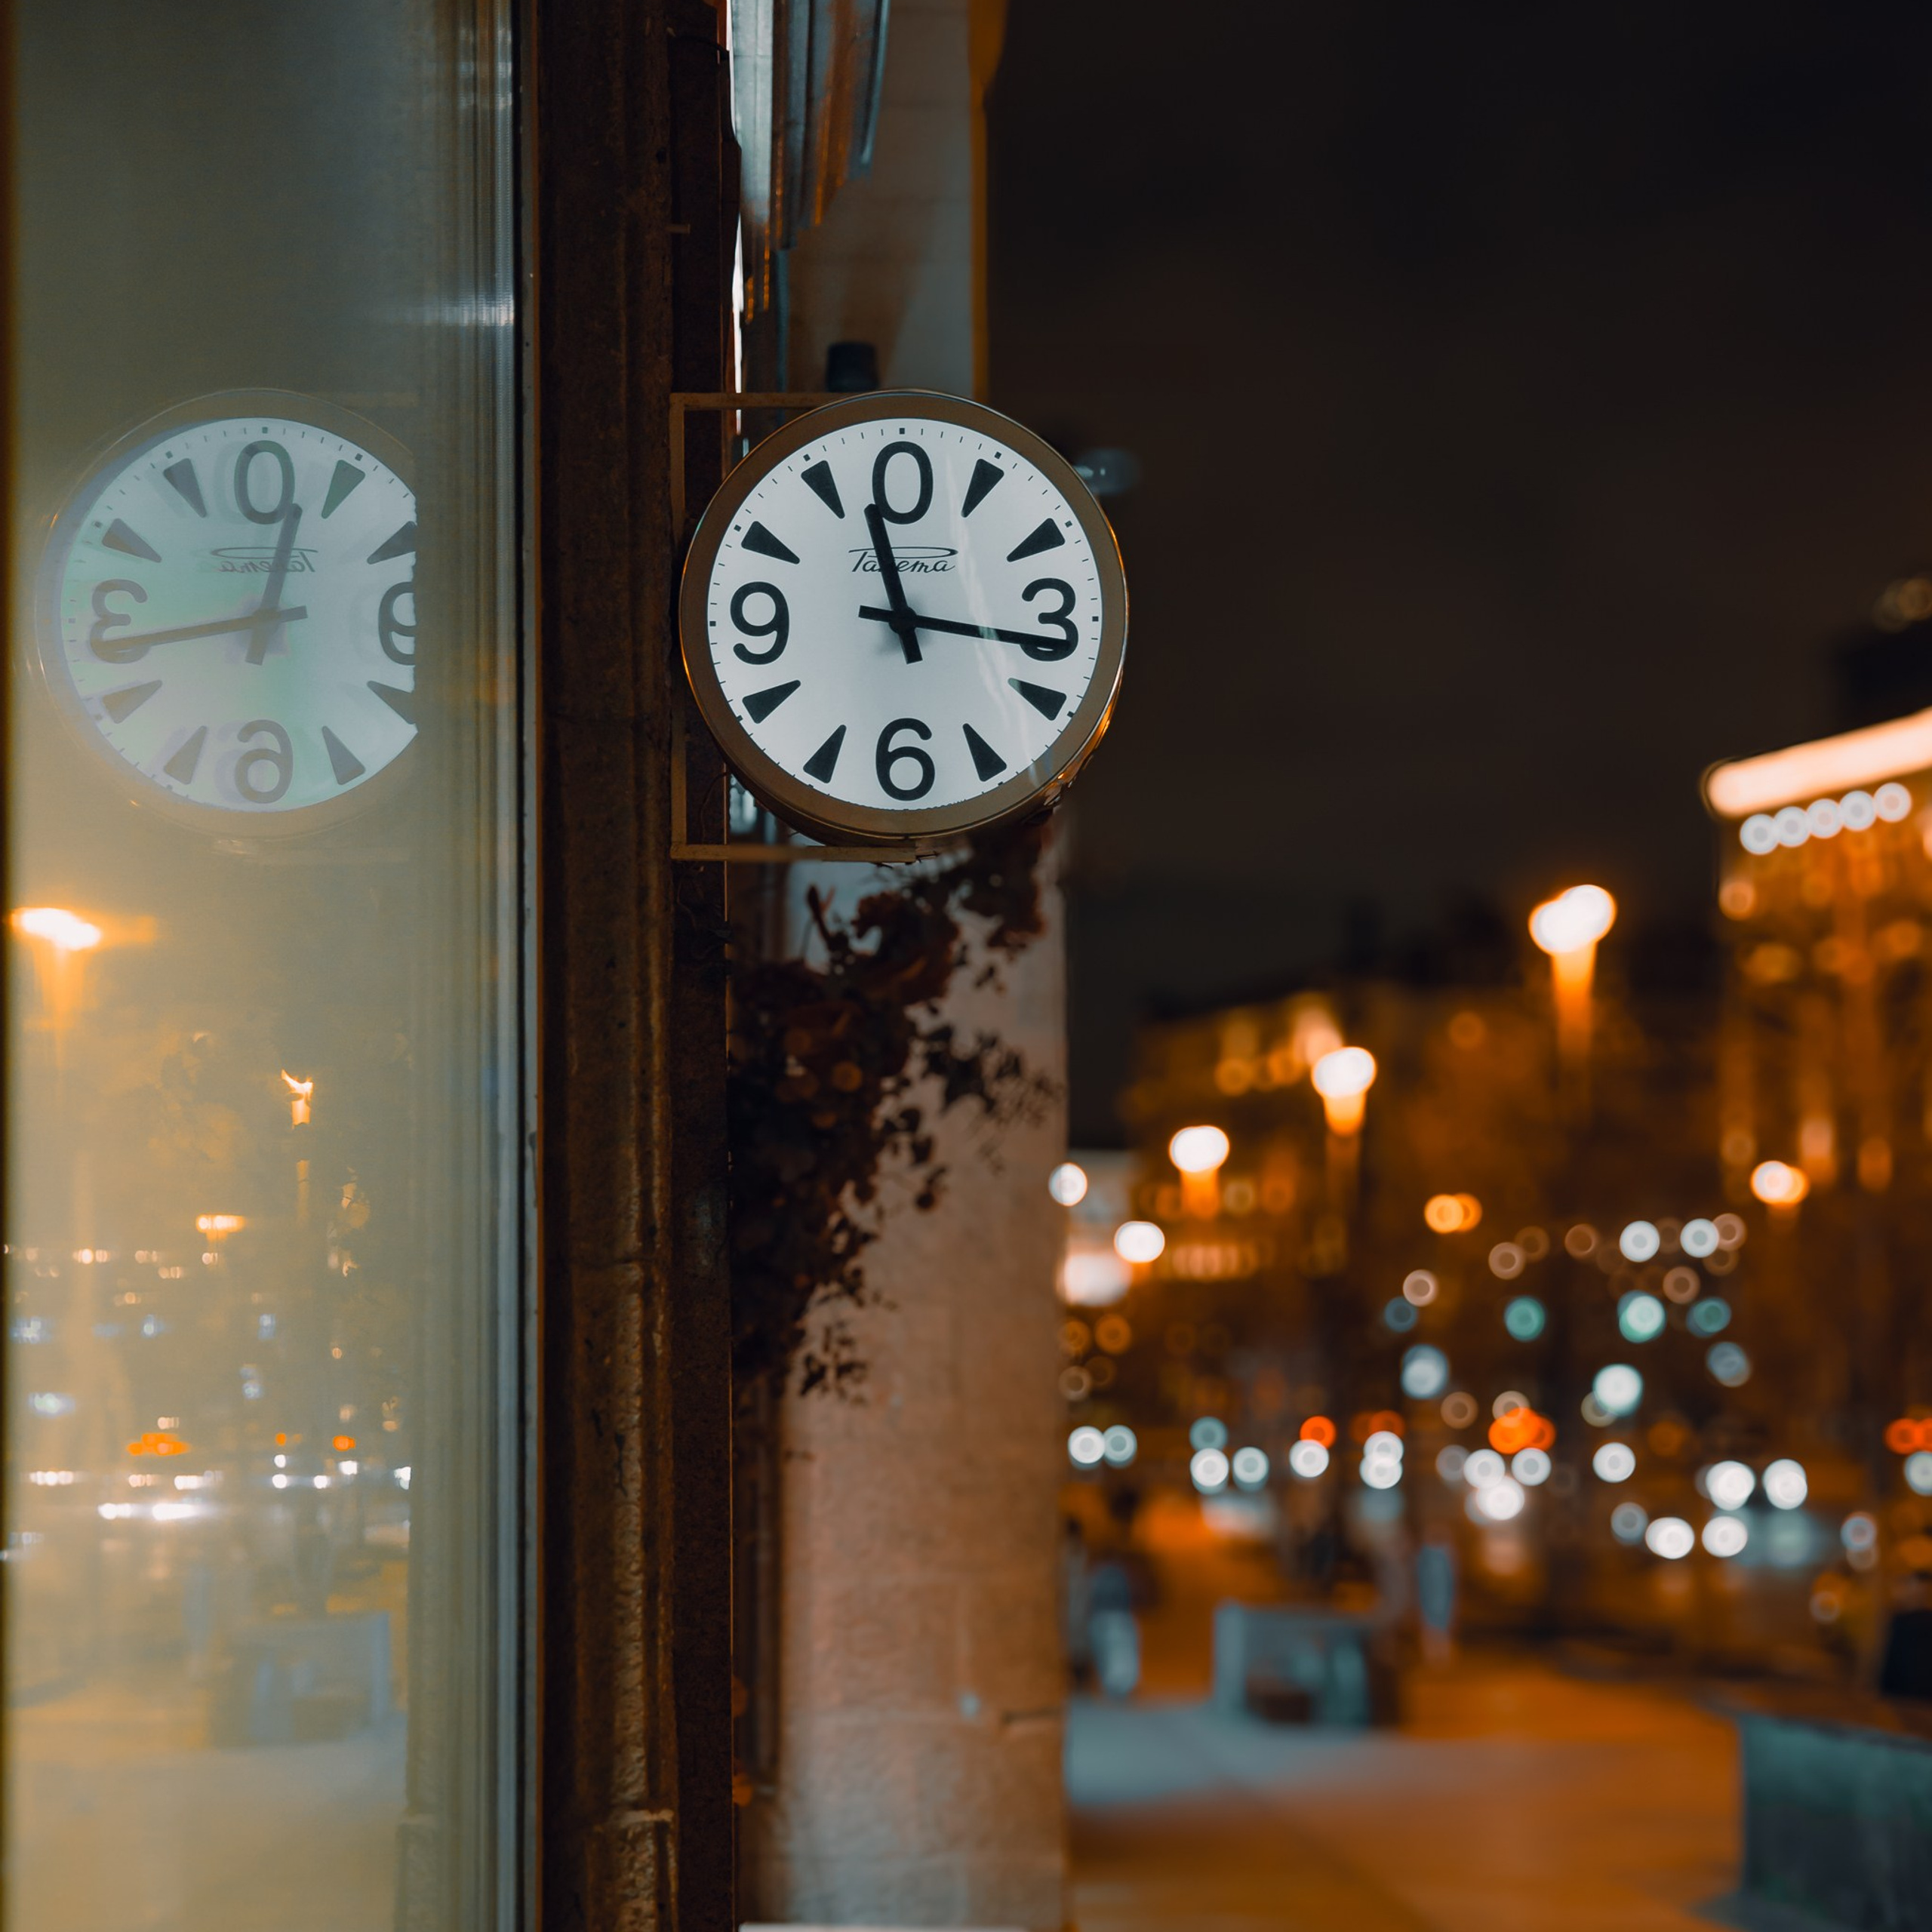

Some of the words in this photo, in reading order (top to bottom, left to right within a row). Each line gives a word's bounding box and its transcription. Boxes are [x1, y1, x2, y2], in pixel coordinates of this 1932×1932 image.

[872, 441, 934, 525] 0
[848, 546, 958, 573] Раета
[730, 581, 790, 665] 9
[1020, 577, 1079, 661] 3
[875, 718, 935, 801] 6
